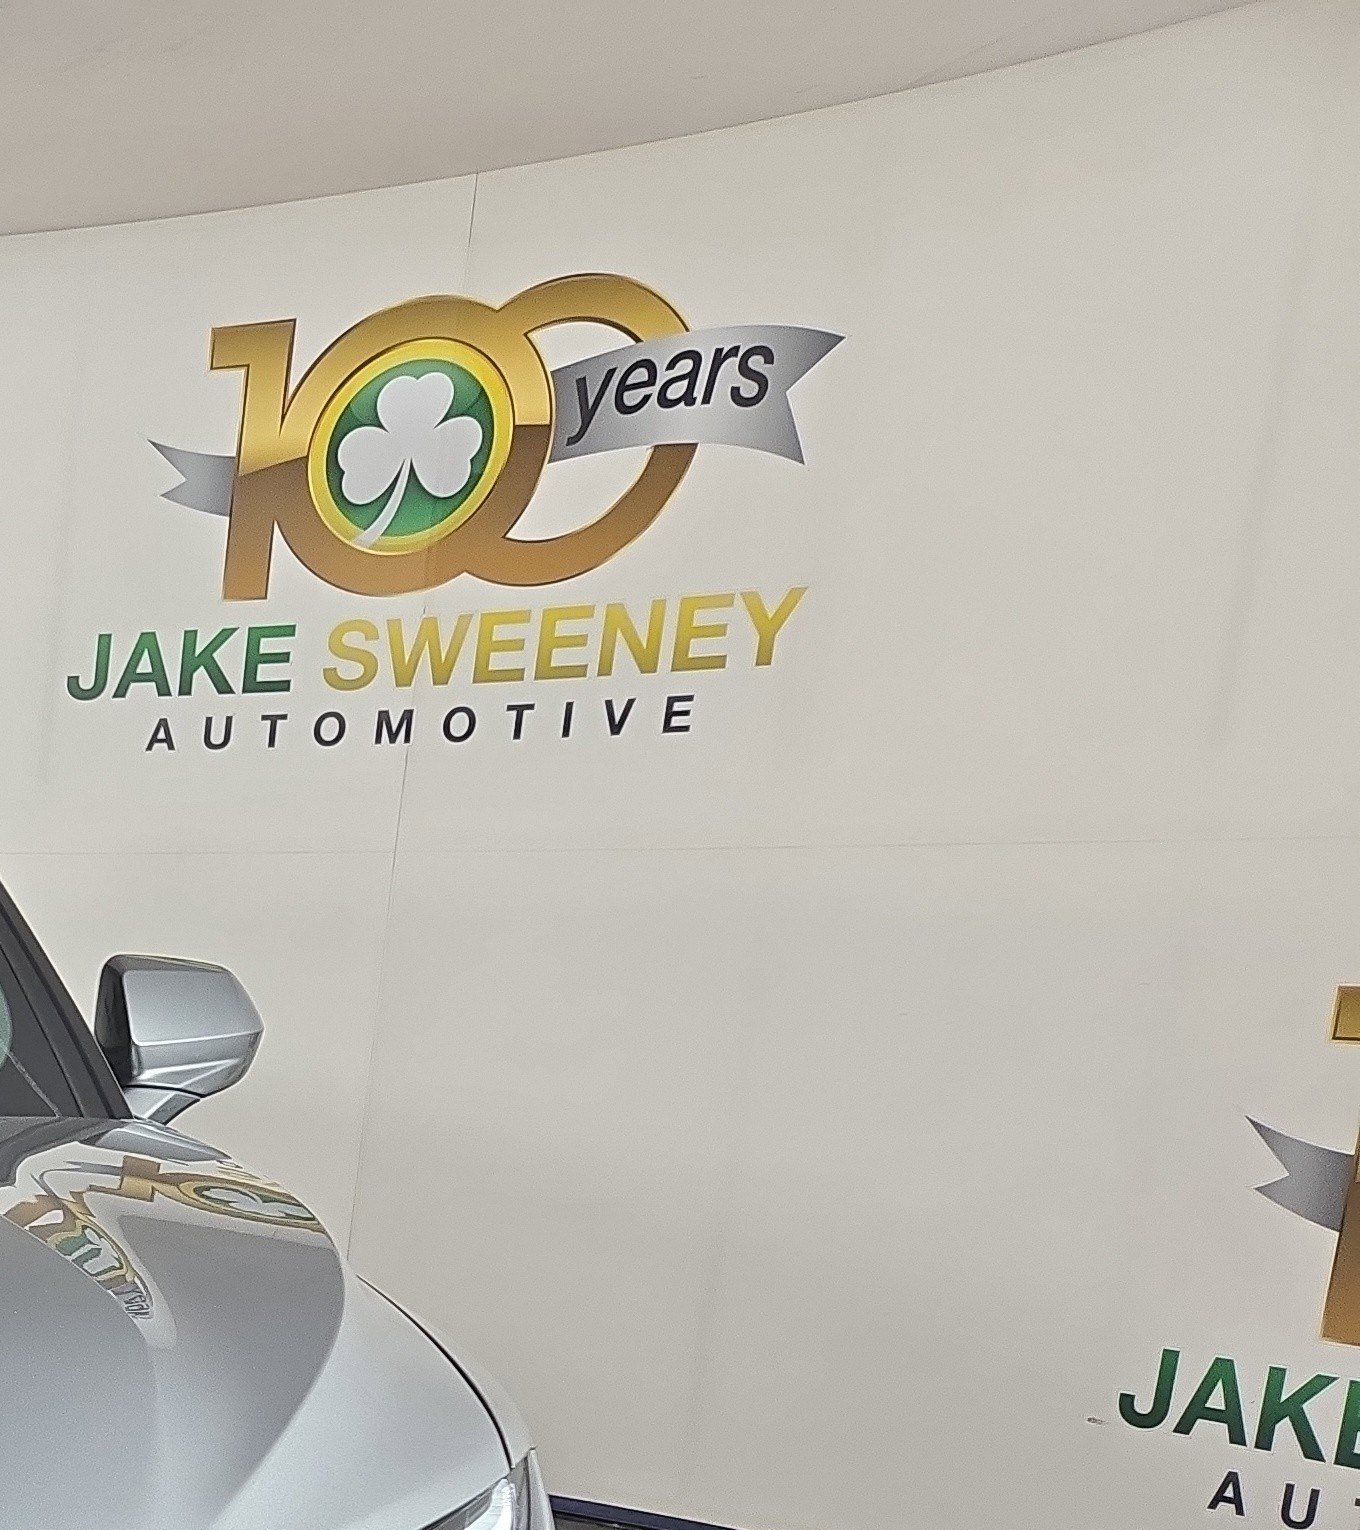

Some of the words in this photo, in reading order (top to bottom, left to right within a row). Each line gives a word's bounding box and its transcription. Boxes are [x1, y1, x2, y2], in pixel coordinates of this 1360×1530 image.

[208, 271, 699, 603] 100
[564, 342, 778, 448] years
[66, 623, 298, 702] JAKE
[321, 585, 809, 693] SWEENEY
[144, 694, 695, 753] AUTOMOTIVE
